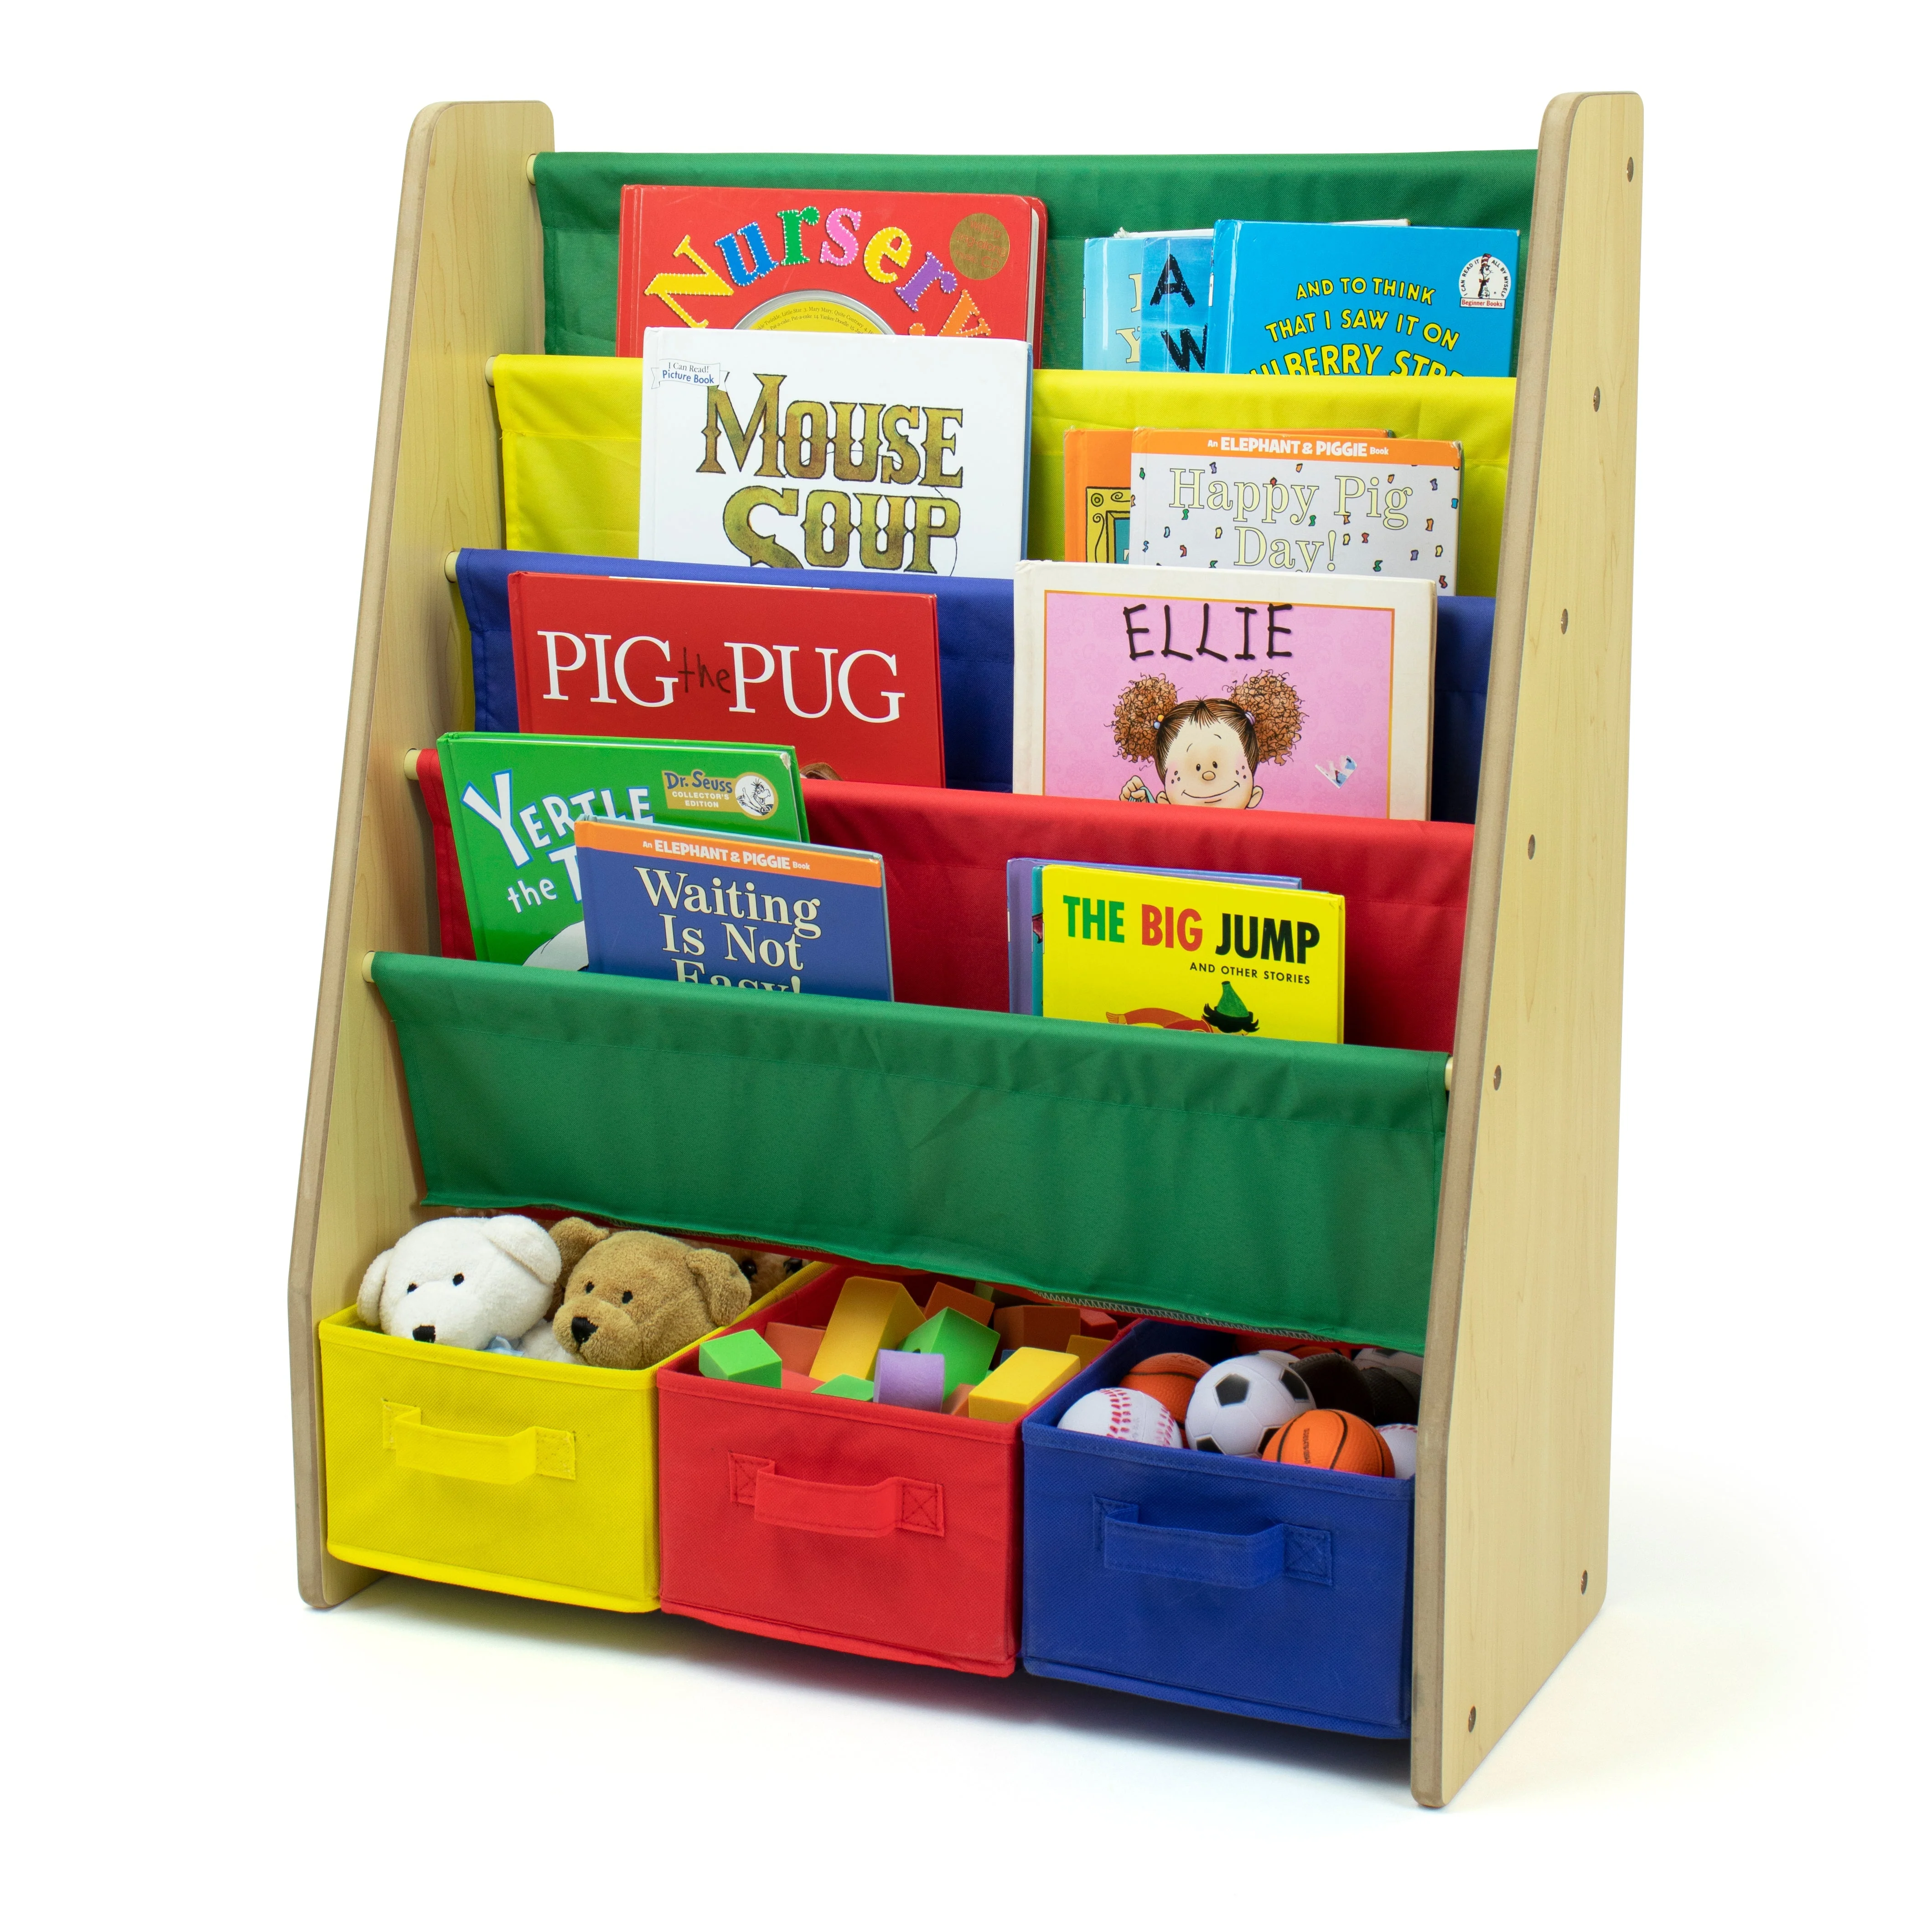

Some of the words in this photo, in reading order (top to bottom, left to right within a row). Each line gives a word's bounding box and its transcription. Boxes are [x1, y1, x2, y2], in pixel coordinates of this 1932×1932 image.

[970, 221, 991, 234] with
[956, 233, 1006, 258] sing-along
[954, 250, 978, 264] music
[981, 256, 1000, 270] CD
[1462, 263, 1473, 277] READ
[1492, 259, 1501, 268] ALL
[1296, 279, 1334, 300] AND
[1340, 277, 1367, 294] TO
[1372, 277, 1436, 305] THINK
[835, 318, 849, 327] Doodle
[846, 315, 864, 328] Contrary
[1265, 312, 1316, 342] THAT
[1324, 310, 1331, 330] I
[1341, 309, 1389, 330] SAW
[1396, 314, 1420, 336] IT
[1422, 323, 1460, 351] ON
[663, 370, 691, 382] Picture
[694, 374, 715, 383] Book
[673, 362, 687, 372] Can
[689, 365, 710, 373] Read!
[1207, 440, 1218, 448] An
[1221, 437, 1300, 454] ELEPHANT
[1302, 442, 1313, 455] &
[1316, 440, 1367, 457] PIGGIE
[1370, 446, 1389, 455] Book
[1169, 468, 1320, 525] Happy
[1334, 475, 1413, 530] Pig
[1233, 526, 1337, 573] Day!
[1123, 602, 1293, 662] ELLIE
[537, 630, 679, 708] PIG
[678, 647, 730, 693] the
[724, 642, 905, 723] PUG
[664, 772, 689, 790] Dr.
[692, 771, 733, 794] Seuss
[672, 791, 730, 800] COLLECTOR'S
[685, 800, 719, 808] EDITION
[460, 768, 654, 870] YERTLE
[654, 839, 728, 861] ELEPHANT
[730, 852, 741, 863] &
[743, 851, 791, 870] PIGGIE
[792, 861, 811, 870] Book
[508, 878, 557, 913] the
[633, 866, 821, 939] Waiting
[659, 913, 705, 956] Is
[721, 922, 804, 971] Not
[1063, 894, 1125, 943] THE
[1141, 903, 1203, 952] BIG
[1215, 912, 1321, 965] JUMP
[1190, 962, 1215, 974] AND
[1221, 966, 1259, 979] OTHER
[1264, 971, 1311, 985] STORIES
